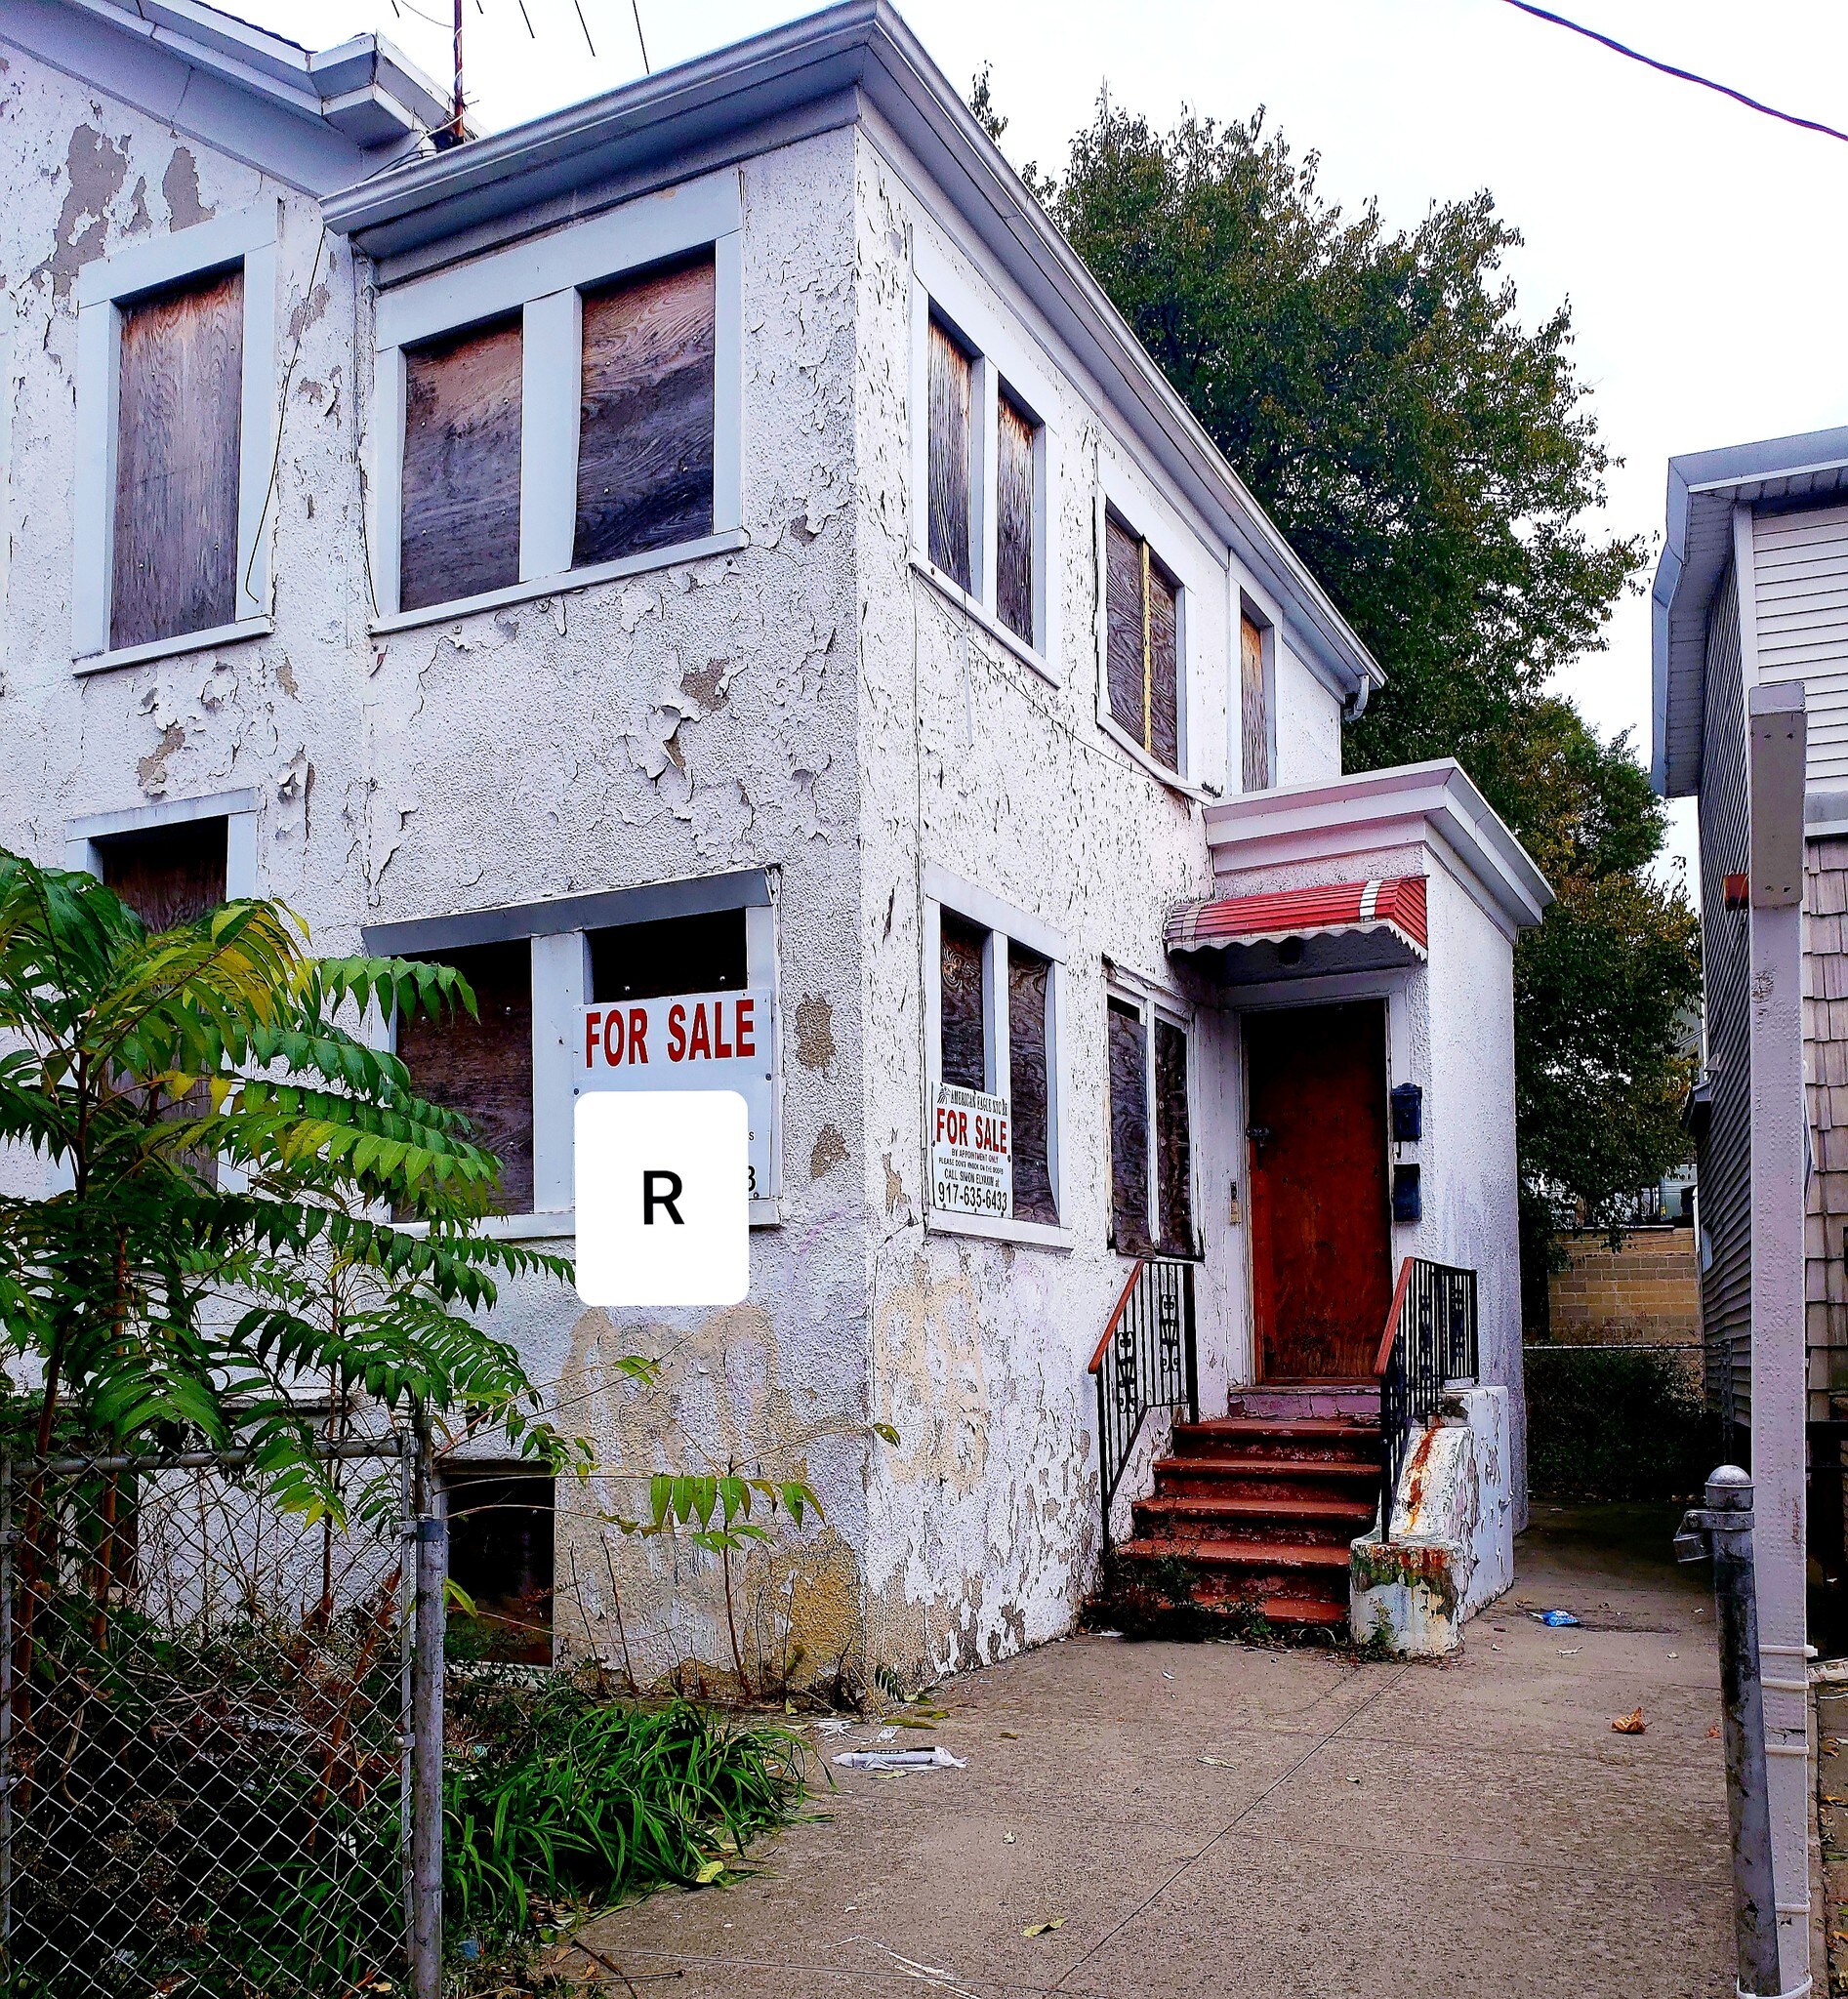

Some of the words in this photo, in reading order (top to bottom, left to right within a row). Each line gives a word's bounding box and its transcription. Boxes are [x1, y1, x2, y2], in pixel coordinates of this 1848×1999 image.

[586, 1007, 649, 1069] FOR
[666, 999, 756, 1063] SALE
[951, 1089, 976, 1109] AMERICAN
[977, 1096, 992, 1113] EAGLE
[936, 1108, 968, 1147] FOR
[975, 1115, 1007, 1155] SALE
[938, 1157, 955, 1166] PLEASE
[967, 1162, 979, 1170] KNOCK
[951, 1148, 958, 1157] BY
[959, 1150, 987, 1162] APPOINTMENT
[988, 1154, 999, 1163] ONLY
[944, 1167, 959, 1181] CALL
[959, 1170, 975, 1184] SIMON
[995, 1178, 1000, 1188] at
[938, 1181, 1007, 1211] 917-635-6433
